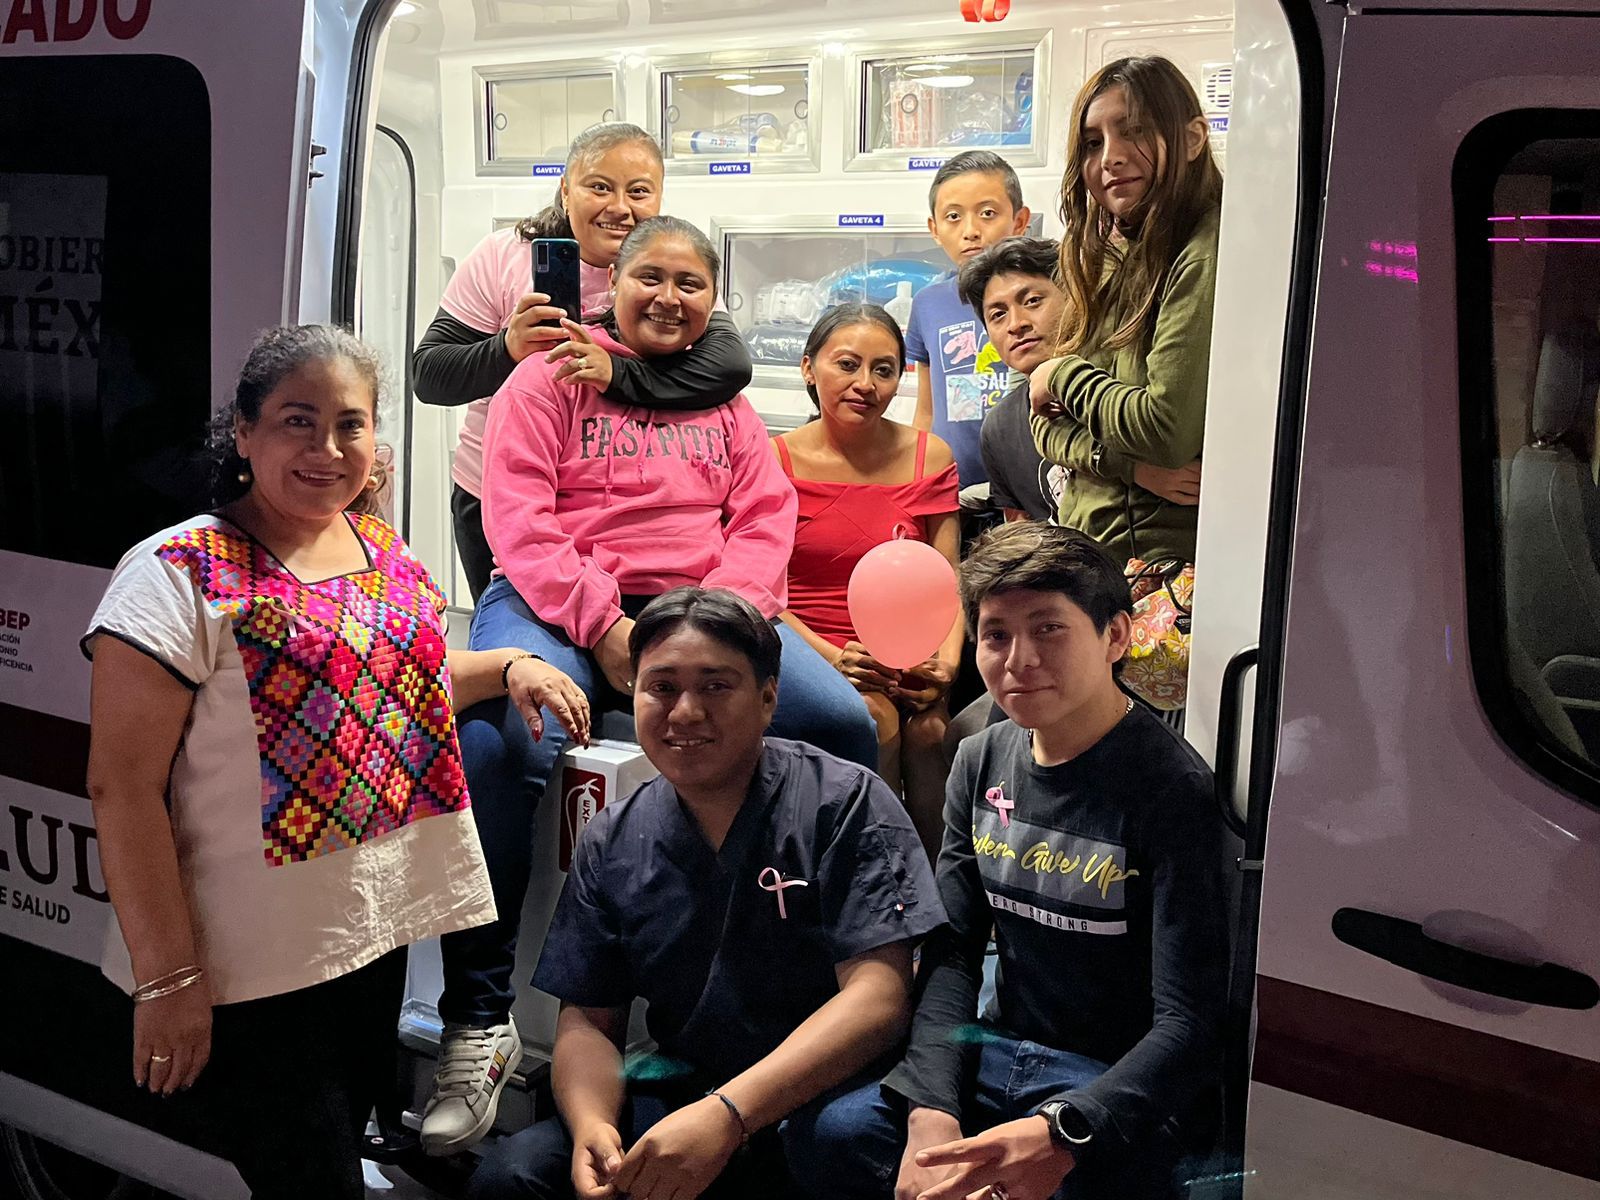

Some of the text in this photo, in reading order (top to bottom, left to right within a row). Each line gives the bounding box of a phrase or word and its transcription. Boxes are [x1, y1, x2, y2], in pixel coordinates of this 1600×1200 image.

[841, 216, 873, 224] GAVETA
[980, 390, 1008, 407] AC
[580, 417, 730, 469] FASTPITC
[0, 632, 20, 645] CIÓN
[582, 799, 591, 824] EXT
[1021, 841, 1081, 873] Give
[1082, 853, 1140, 900] Up
[11, 890, 71, 924] SALUD
[1029, 905, 1088, 931] STRONG
